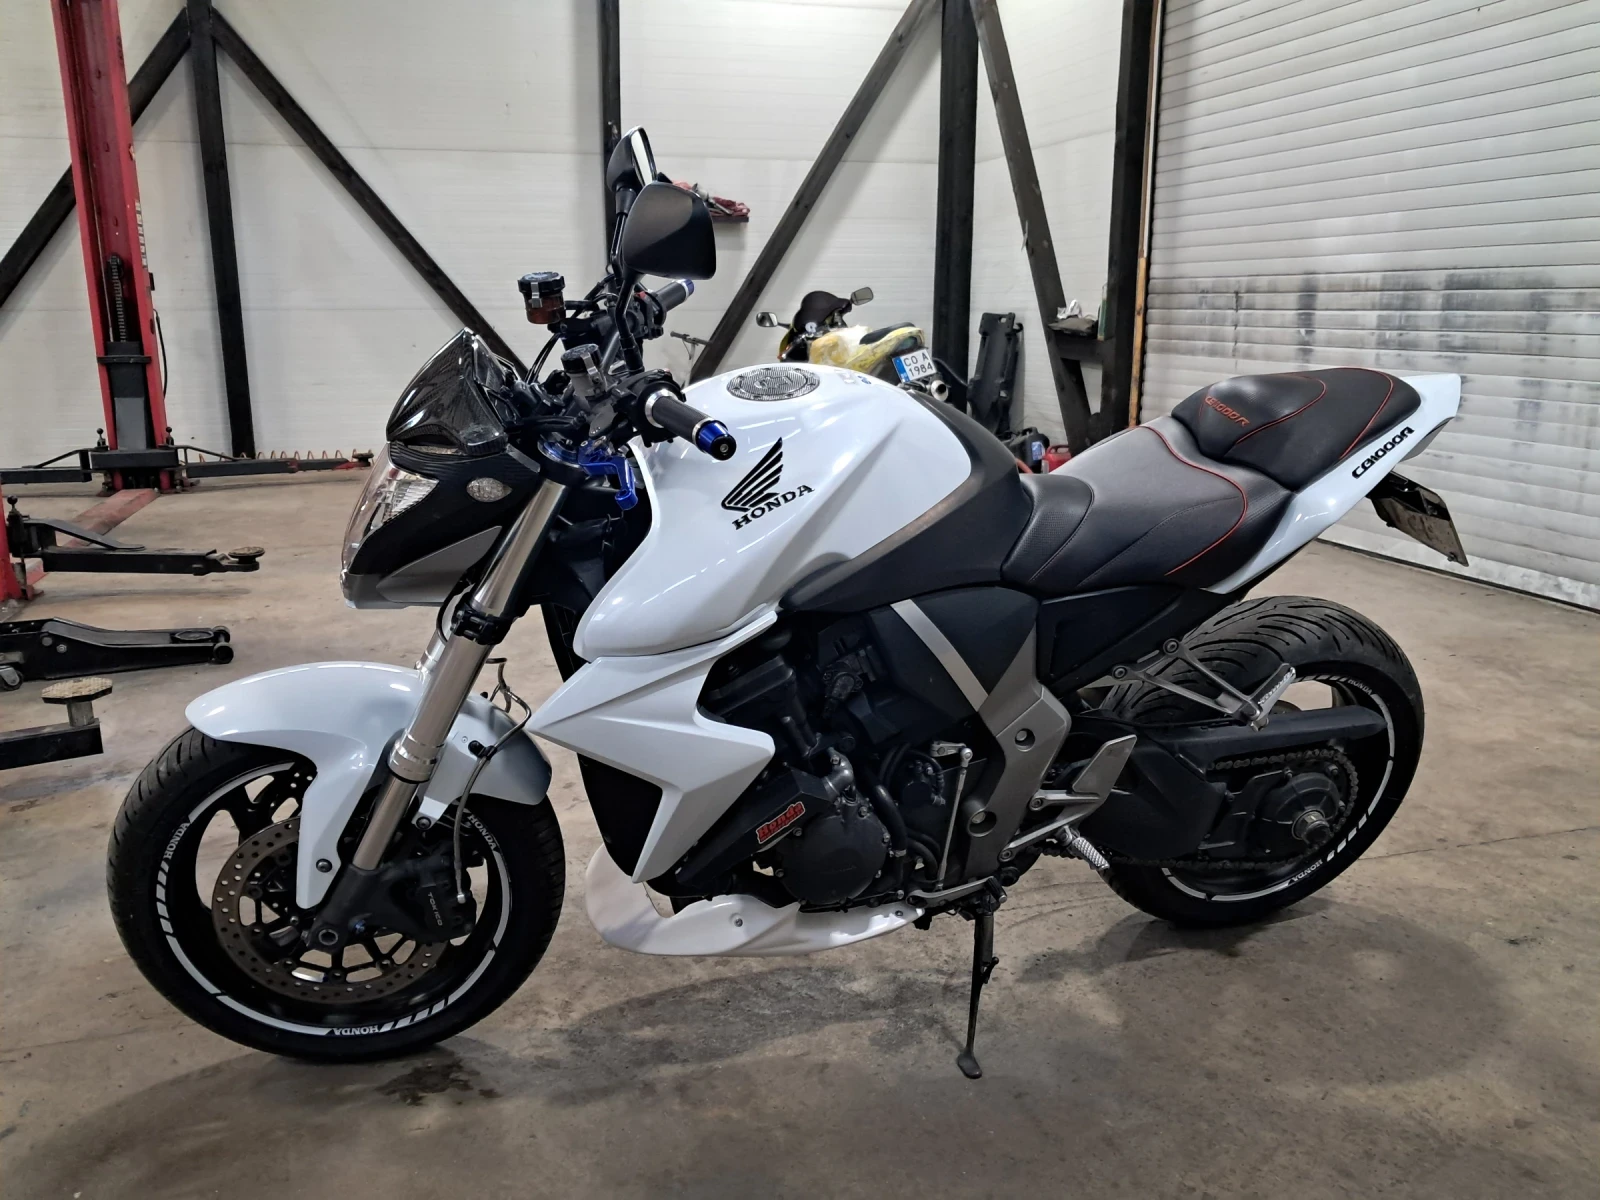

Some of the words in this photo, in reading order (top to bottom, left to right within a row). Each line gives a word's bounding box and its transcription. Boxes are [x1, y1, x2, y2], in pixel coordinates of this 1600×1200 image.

[903, 355, 918, 367] CO
[921, 352, 929, 361] A
[909, 362, 933, 377] 1984
[1351, 426, 1415, 479] CB1000R
[731, 484, 815, 530] HONDA
[1347, 679, 1372, 695] HONDA
[467, 814, 496, 850] HONDA
[757, 803, 804, 838] Honda
[163, 822, 190, 860] HONDA
[1291, 859, 1323, 881] HONDA
[428, 891, 443, 926] TOKICO
[332, 1024, 379, 1036] HONDA
